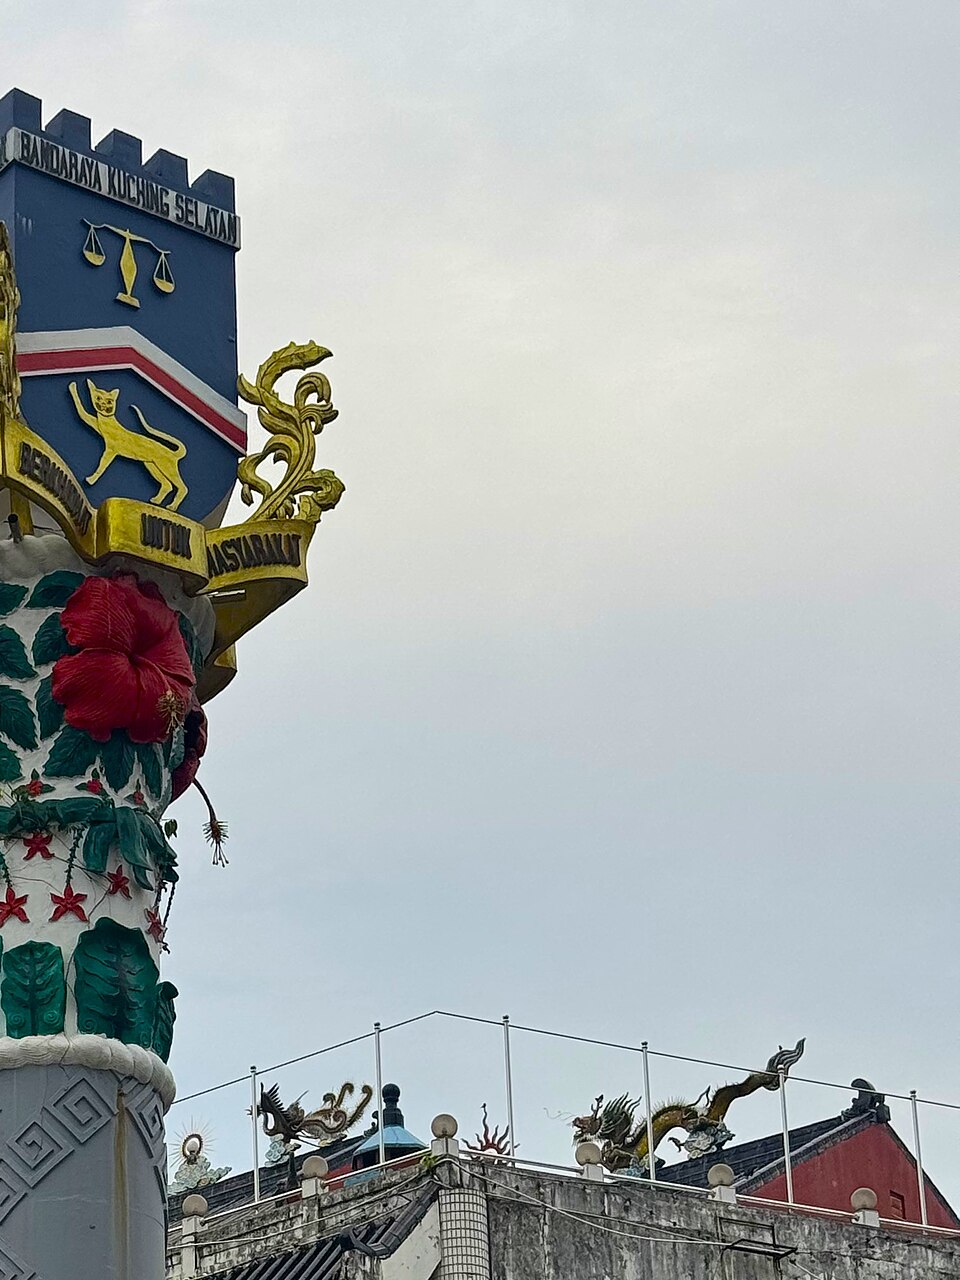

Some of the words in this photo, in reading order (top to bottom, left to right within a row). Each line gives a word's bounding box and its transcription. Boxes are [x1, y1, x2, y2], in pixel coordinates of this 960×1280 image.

[19, 131, 103, 193] BANDARAYA
[107, 165, 171, 218] KUCHING
[174, 192, 238, 245] SELATAN
[140, 512, 192, 559] UNTUK
